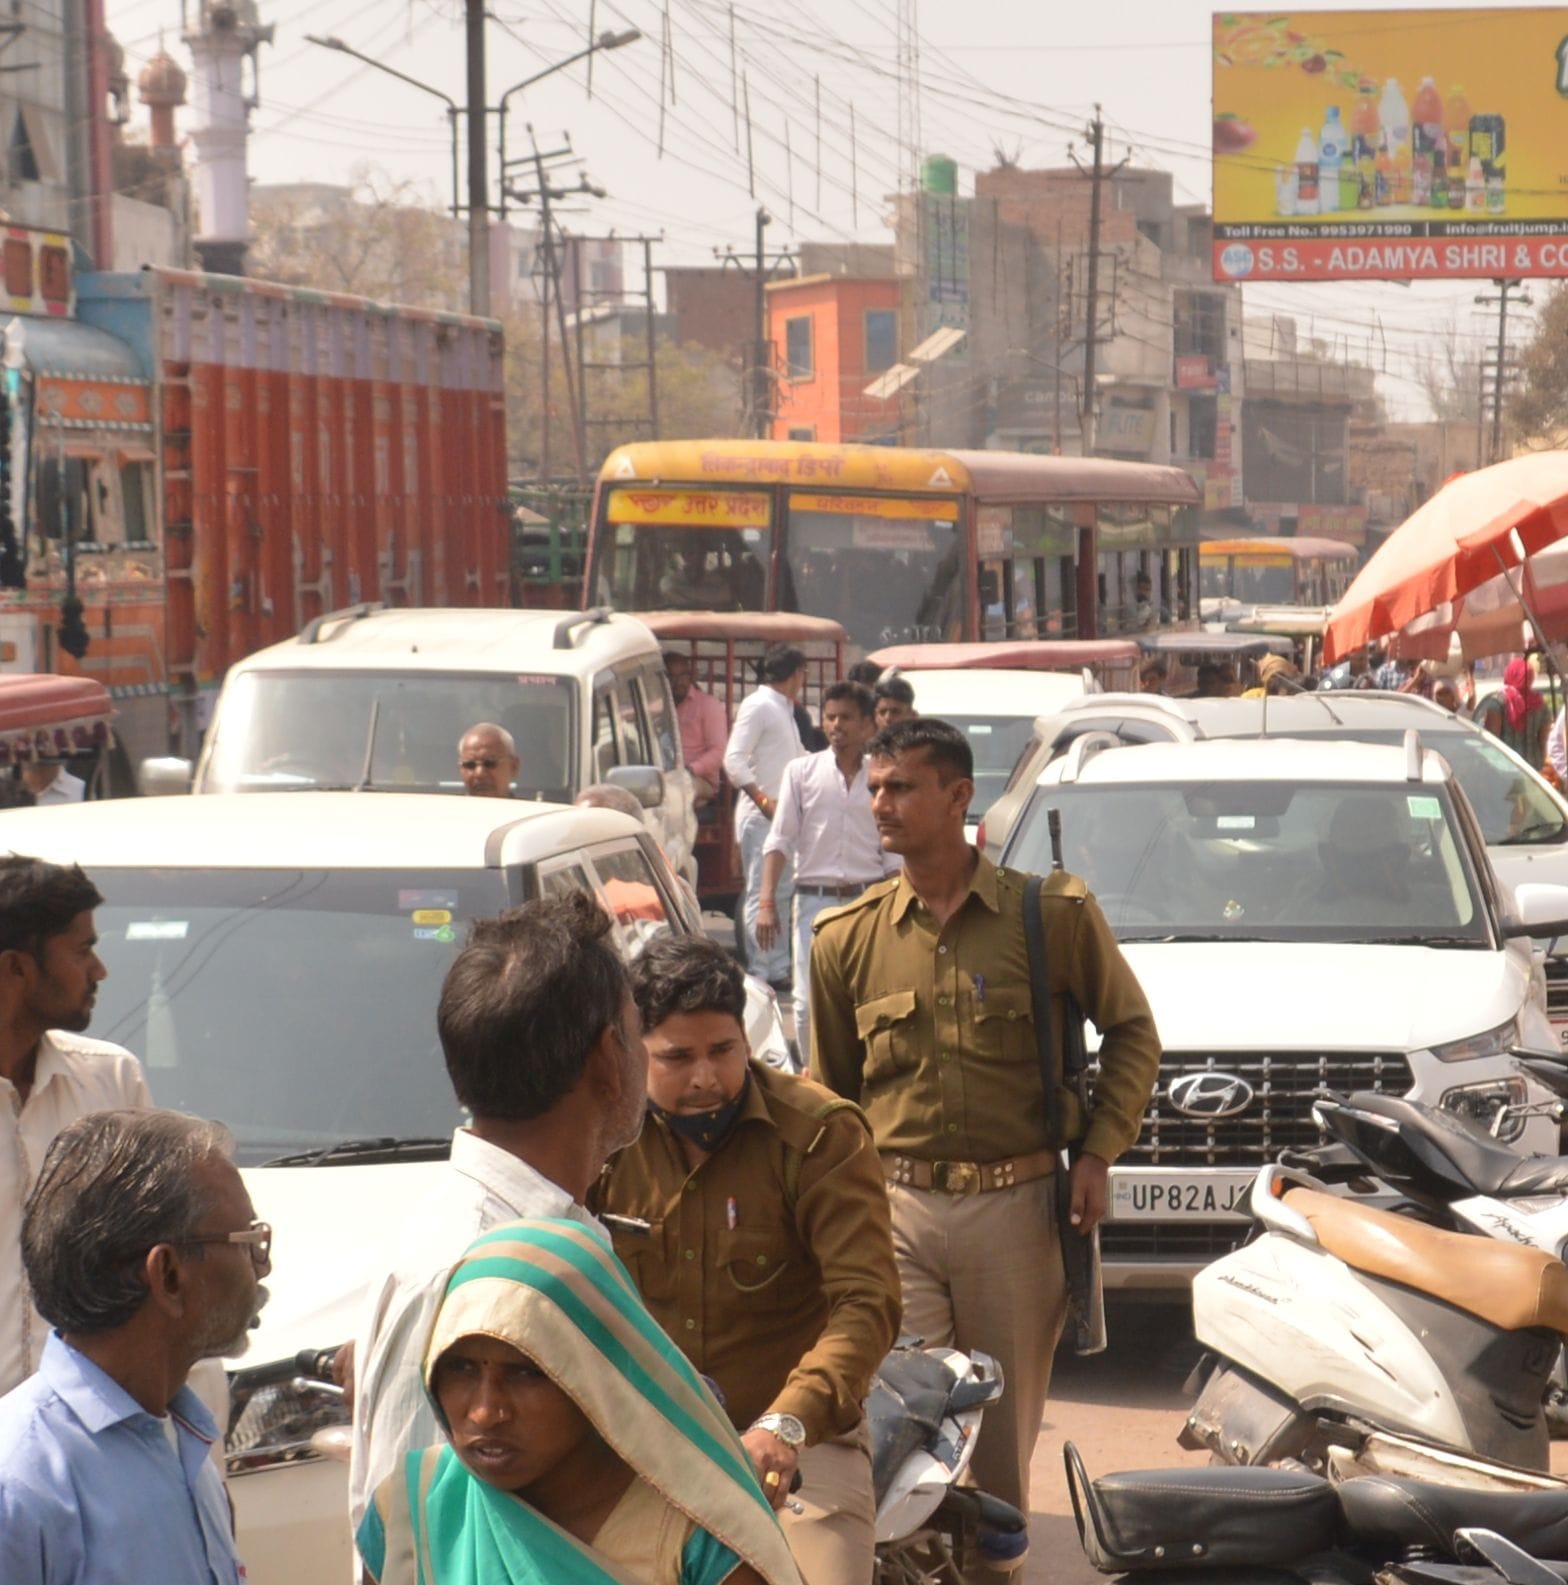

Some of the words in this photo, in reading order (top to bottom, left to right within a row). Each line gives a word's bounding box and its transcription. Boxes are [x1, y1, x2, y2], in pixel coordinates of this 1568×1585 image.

[1224, 226, 1250, 237] Toll
[1254, 226, 1285, 236] Free
[1320, 223, 1412, 236] 9953971990
[1258, 248, 1306, 271] S.S.
[1328, 247, 1438, 271] ADAMYA
[1445, 245, 1506, 270] SHRI
[1514, 245, 1531, 268] &
